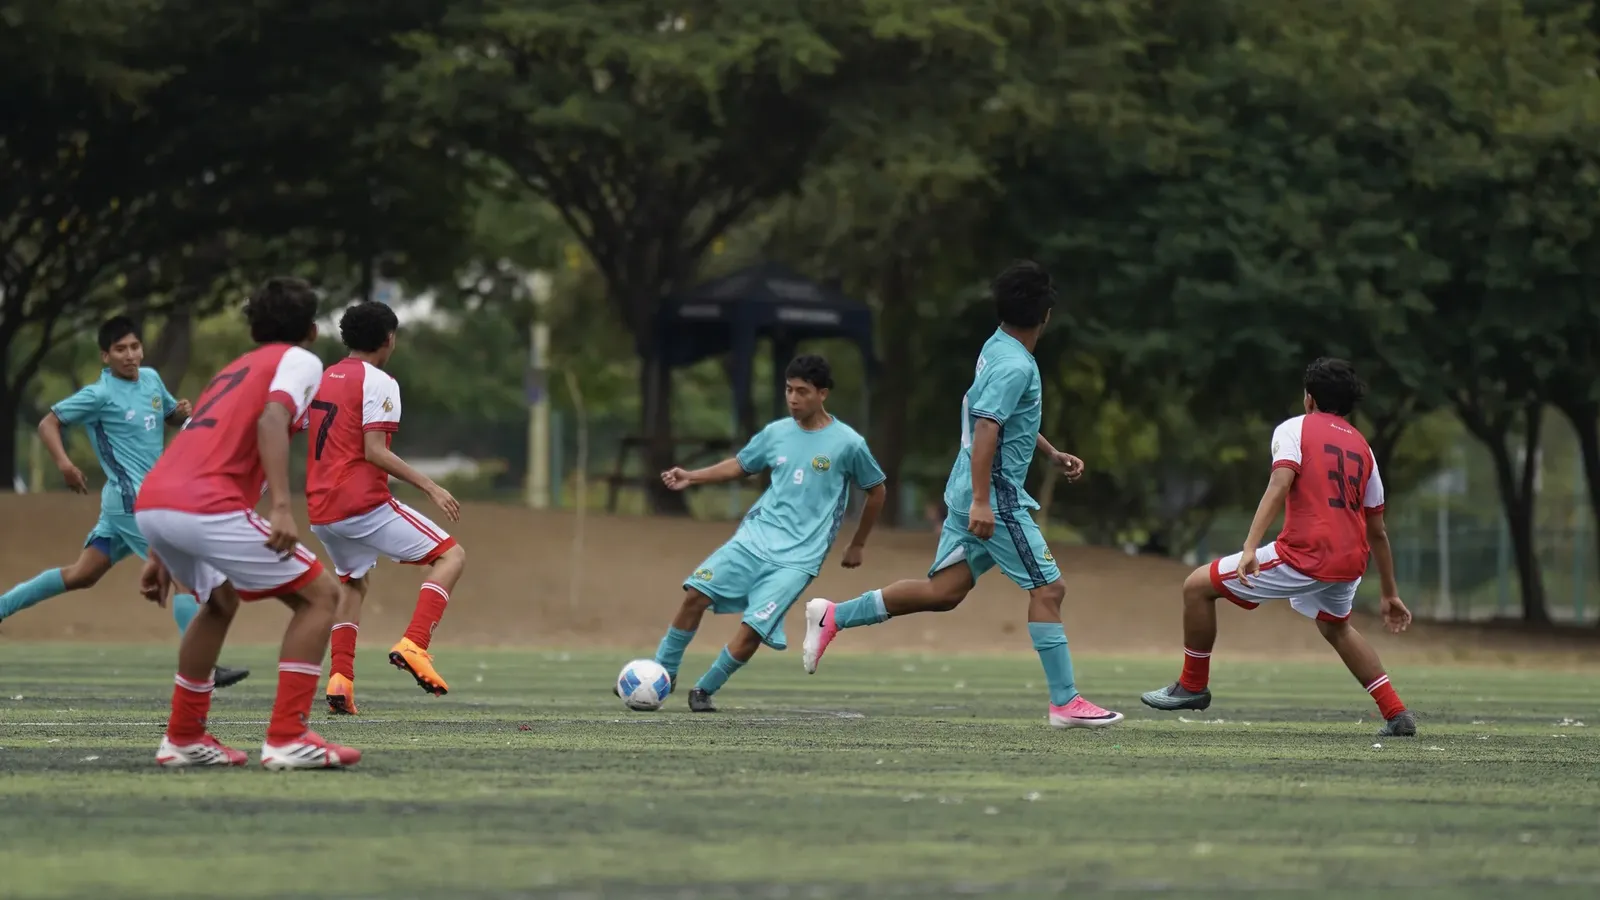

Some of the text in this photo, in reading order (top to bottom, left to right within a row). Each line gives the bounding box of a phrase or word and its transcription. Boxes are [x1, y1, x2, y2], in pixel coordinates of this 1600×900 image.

[186, 366, 250, 430] 2
[310, 399, 338, 461] 7
[793, 468, 804, 485] 9
[1323, 444, 1364, 512] 33
